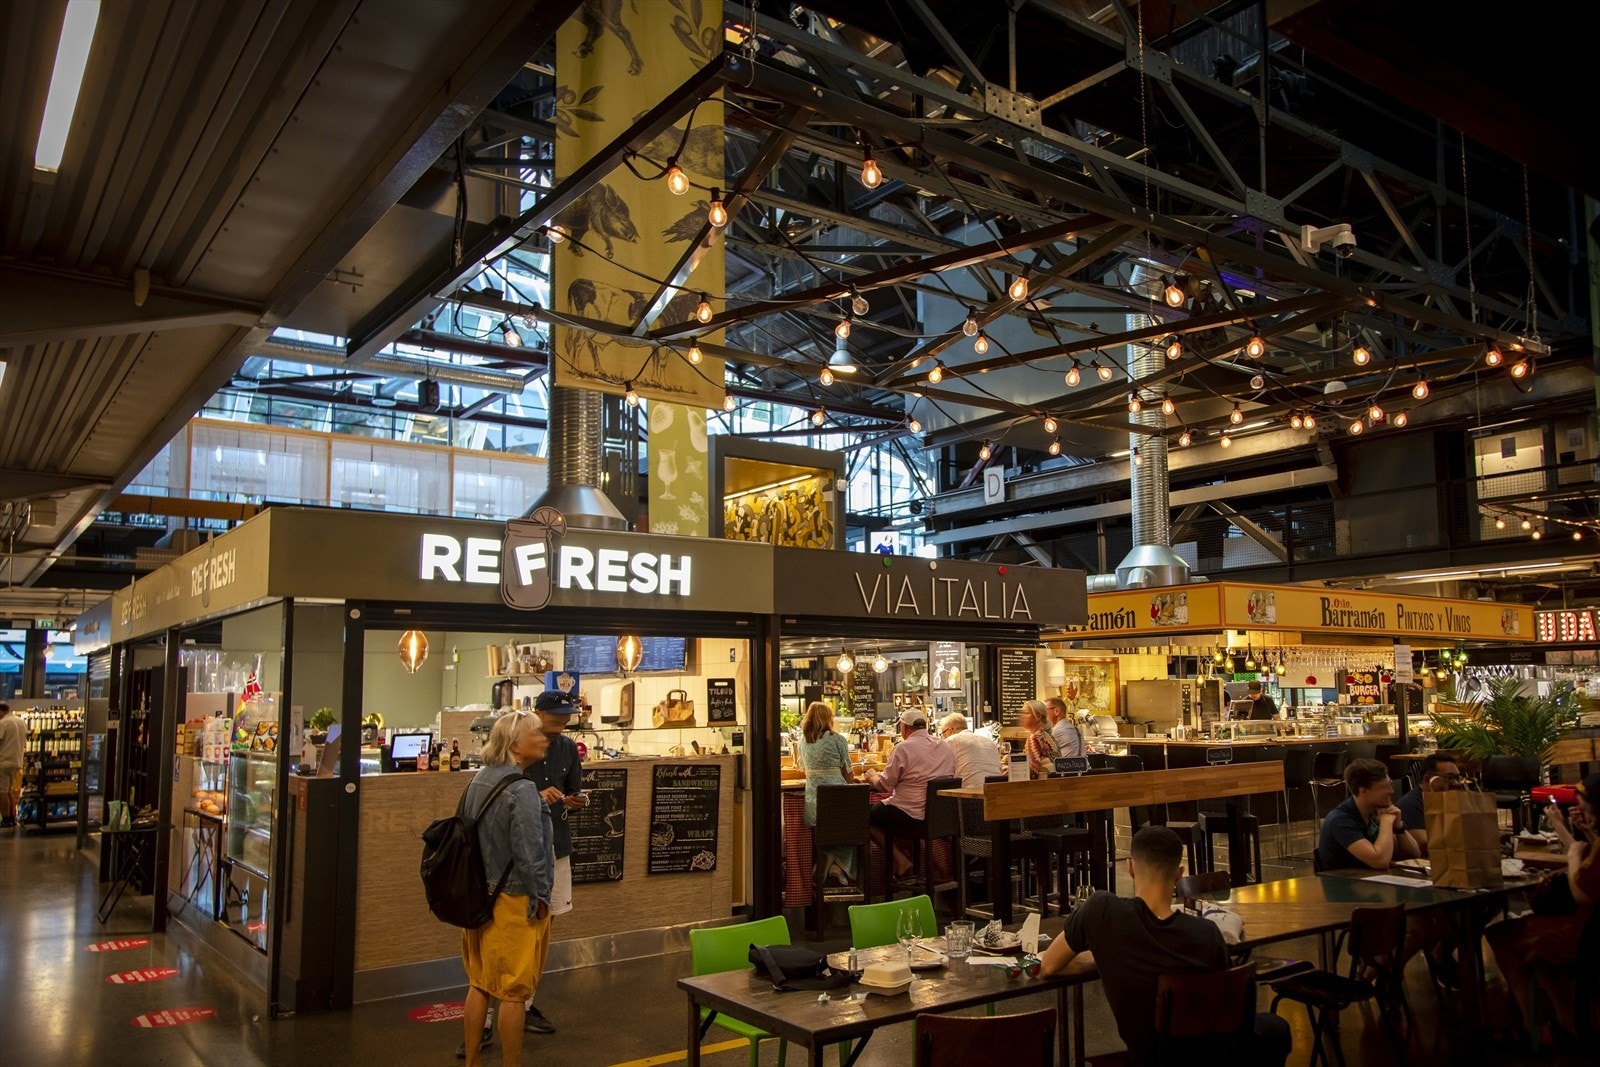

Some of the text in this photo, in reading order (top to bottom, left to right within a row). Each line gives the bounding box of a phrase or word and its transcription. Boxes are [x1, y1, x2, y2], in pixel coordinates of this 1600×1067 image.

[988, 473, 1000, 497] D
[191, 548, 236, 598] REFRESH
[420, 533, 692, 596] REFRESH
[855, 571, 1032, 620] VIA ITALIA
[1320, 597, 1386, 629] Barramón
[1349, 685, 1380, 696] BURGER
[597, 780, 624, 788] COFFEE
[672, 779, 718, 787] SANDWICHES
[687, 830, 715, 838] WRAPS
